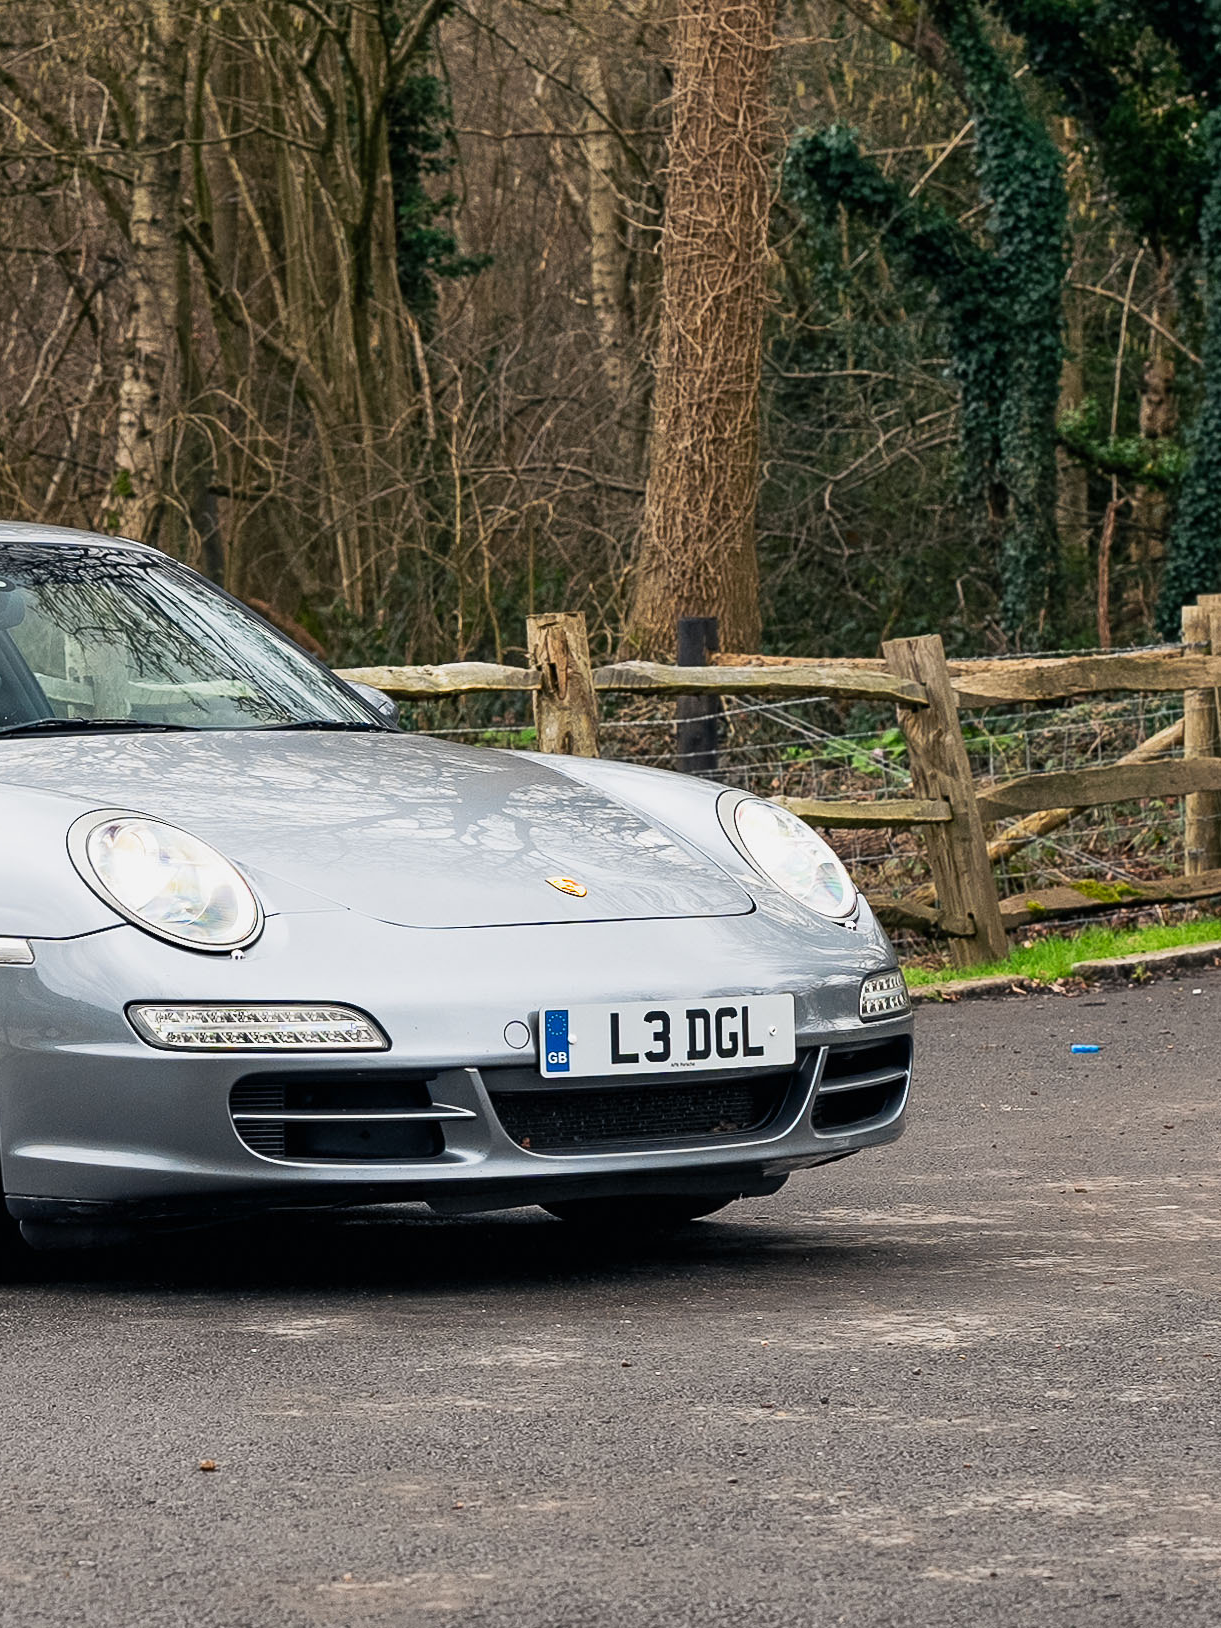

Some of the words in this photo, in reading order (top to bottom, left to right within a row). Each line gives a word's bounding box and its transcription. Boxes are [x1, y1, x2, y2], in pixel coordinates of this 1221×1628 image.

[610, 1010, 671, 1065] L3
[685, 1006, 765, 1061] DGL
[547, 1051, 568, 1064] GB
